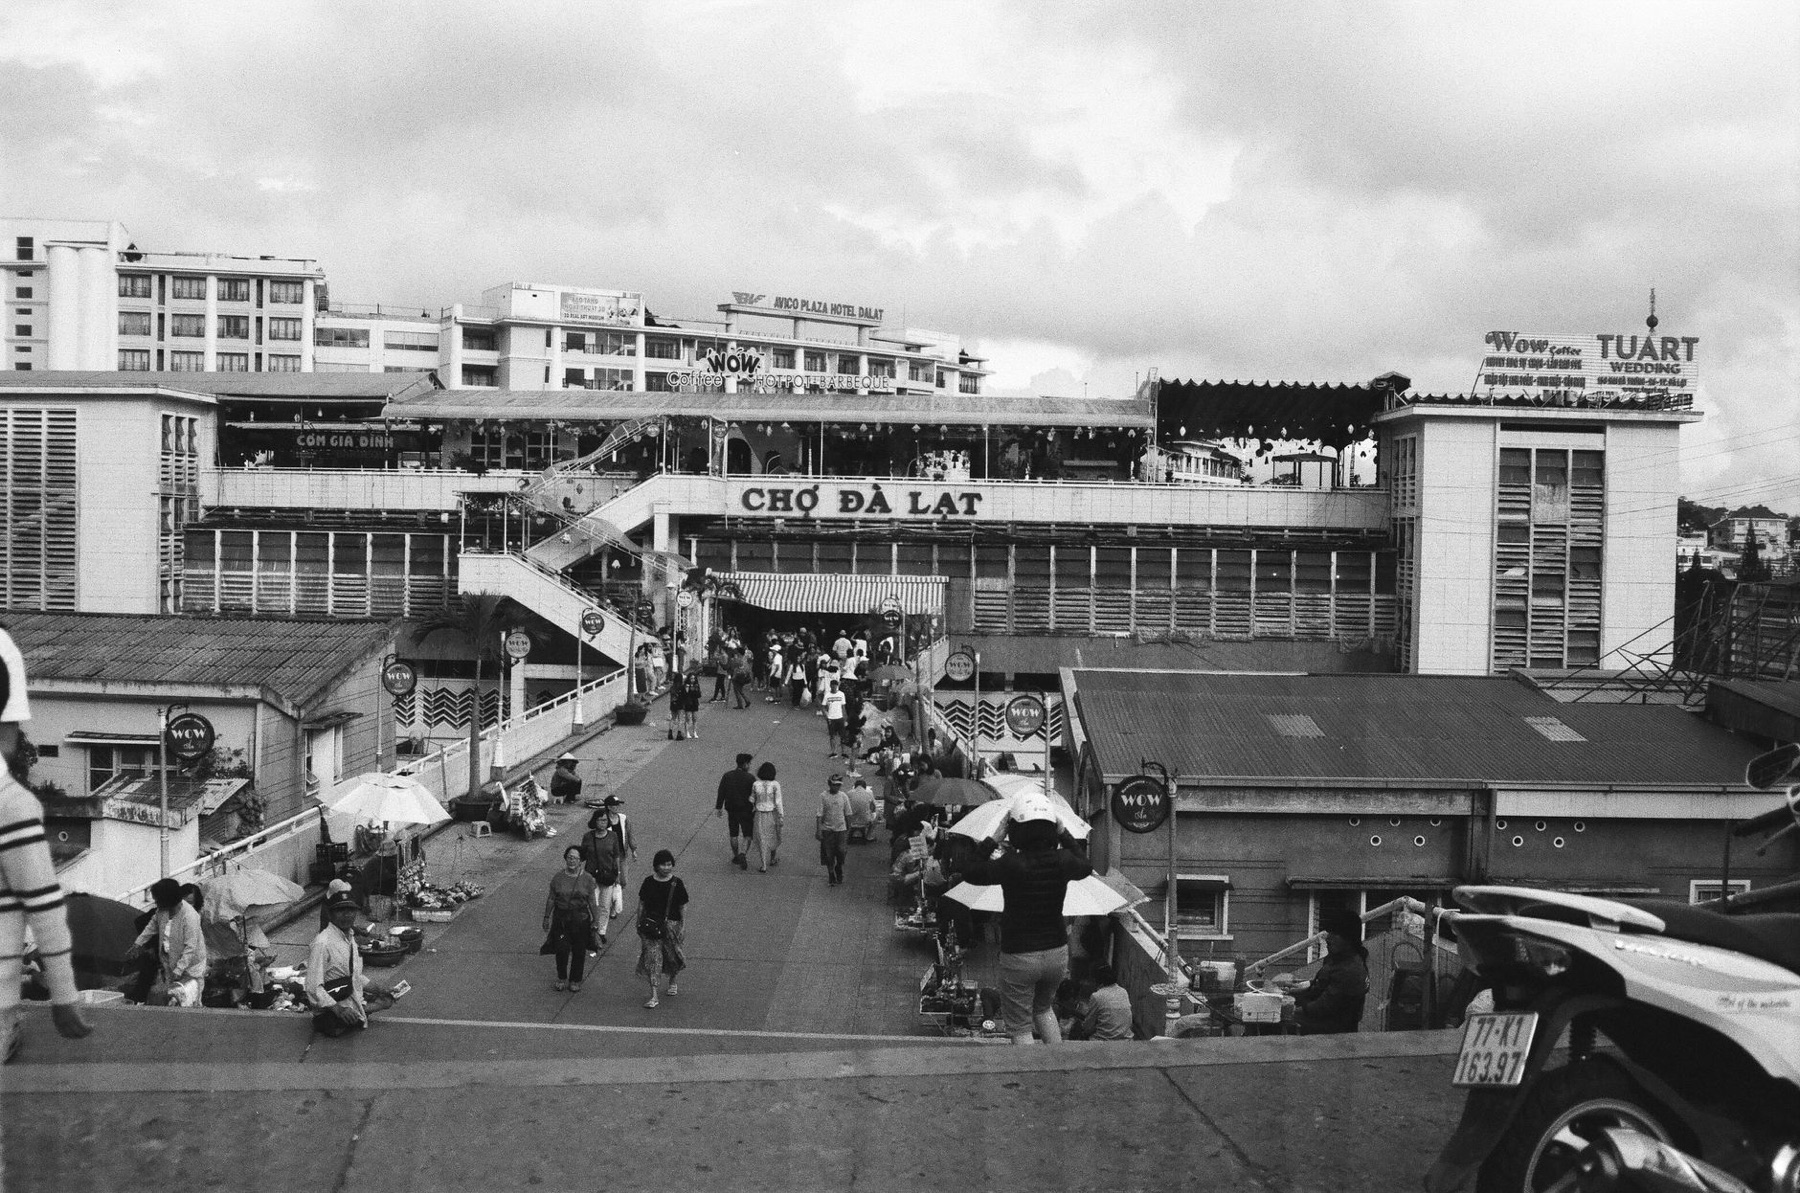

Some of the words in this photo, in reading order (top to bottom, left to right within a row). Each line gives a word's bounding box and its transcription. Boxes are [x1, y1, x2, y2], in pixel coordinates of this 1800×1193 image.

[774, 296, 799, 310] AVICO
[801, 299, 828, 314] PLAZA
[831, 303, 856, 317] HOTEL
[859, 307, 884, 320] DALAT
[1485, 330, 1549, 353] Wow
[1597, 334, 1699, 361] TUART
[707, 353, 760, 373] WOW
[1609, 361, 1681, 374] WEDDING
[667, 371, 722, 386] Coffee
[329, 435, 354, 447] GIA
[741, 484, 819, 518] CHỢ
[839, 483, 892, 514] ĐÀ
[908, 491, 983, 520] LẠT
[386, 672, 411, 680] WOW
[1011, 708, 1040, 717] WOW
[171, 728, 207, 739] WOW
[1120, 794, 1163, 806] WOW
